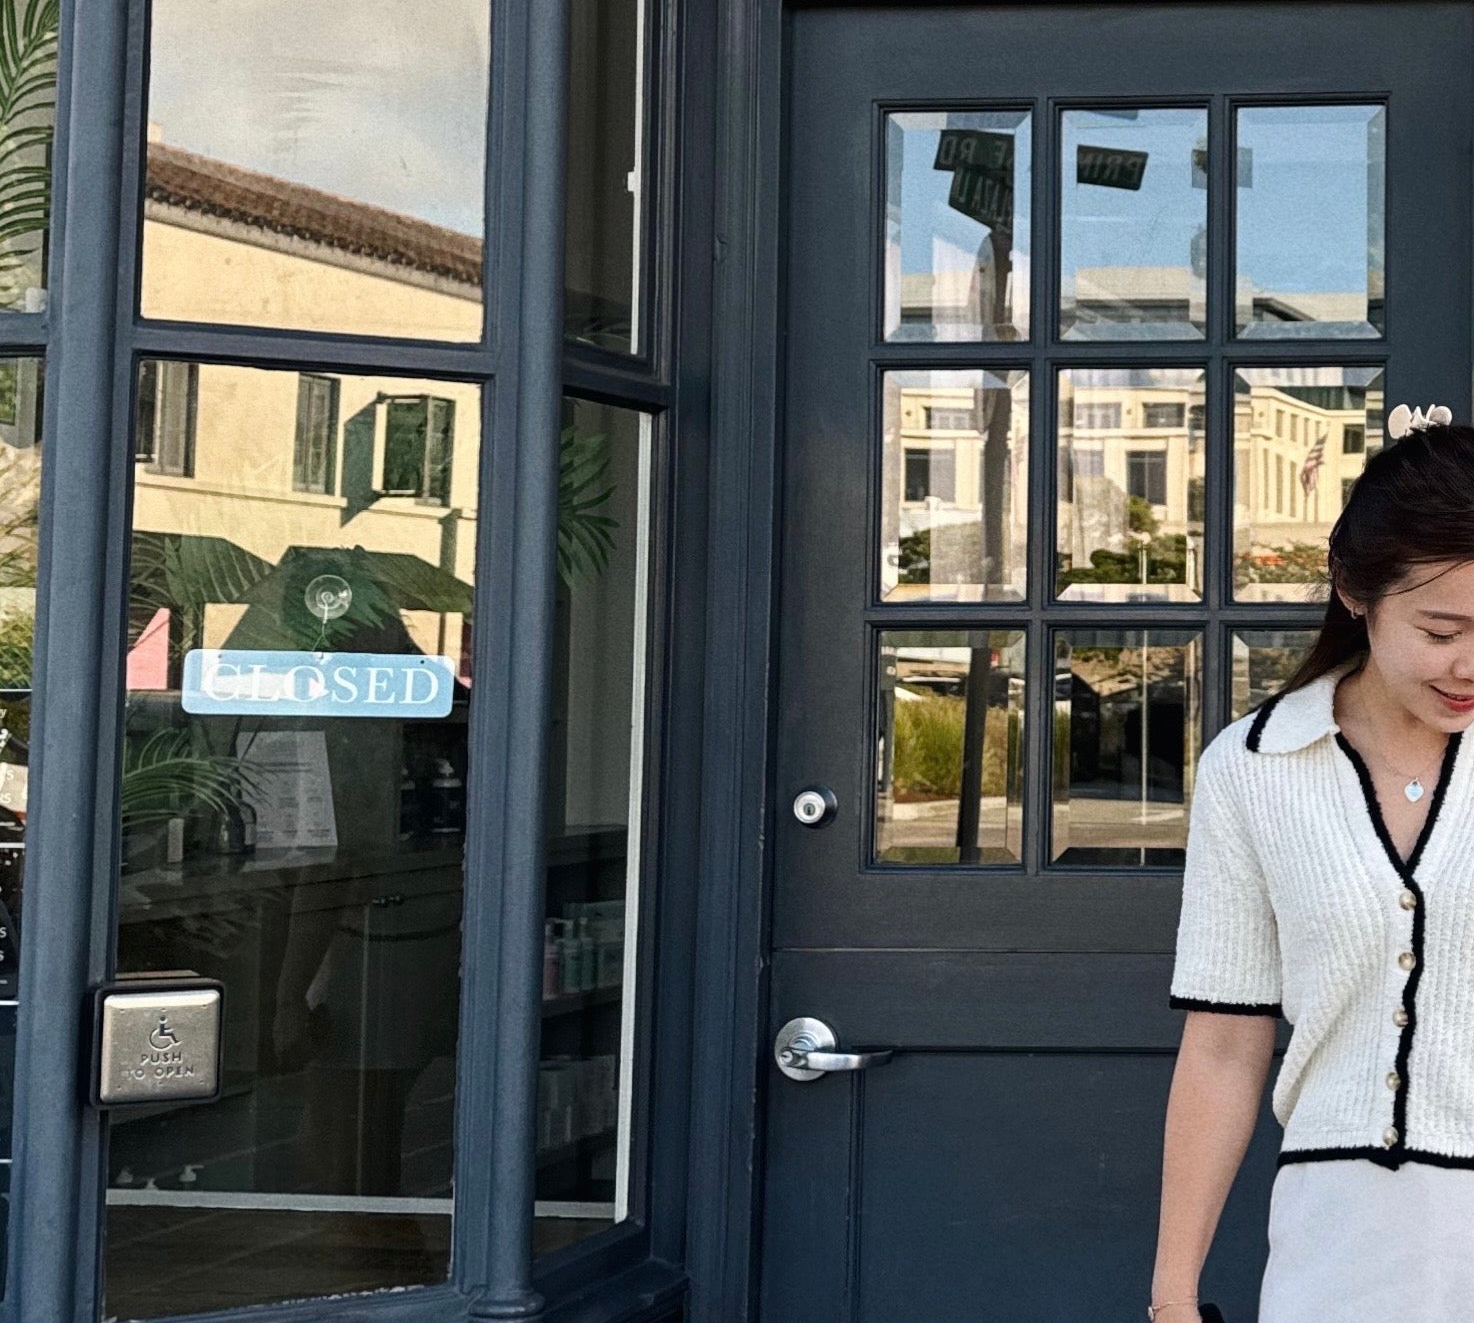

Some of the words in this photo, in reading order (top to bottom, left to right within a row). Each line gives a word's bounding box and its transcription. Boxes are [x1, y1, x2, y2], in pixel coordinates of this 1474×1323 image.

[204, 662, 439, 705] CLOSED
[141, 1052, 183, 1066] PUSH
[154, 1064, 195, 1079] OPEN
